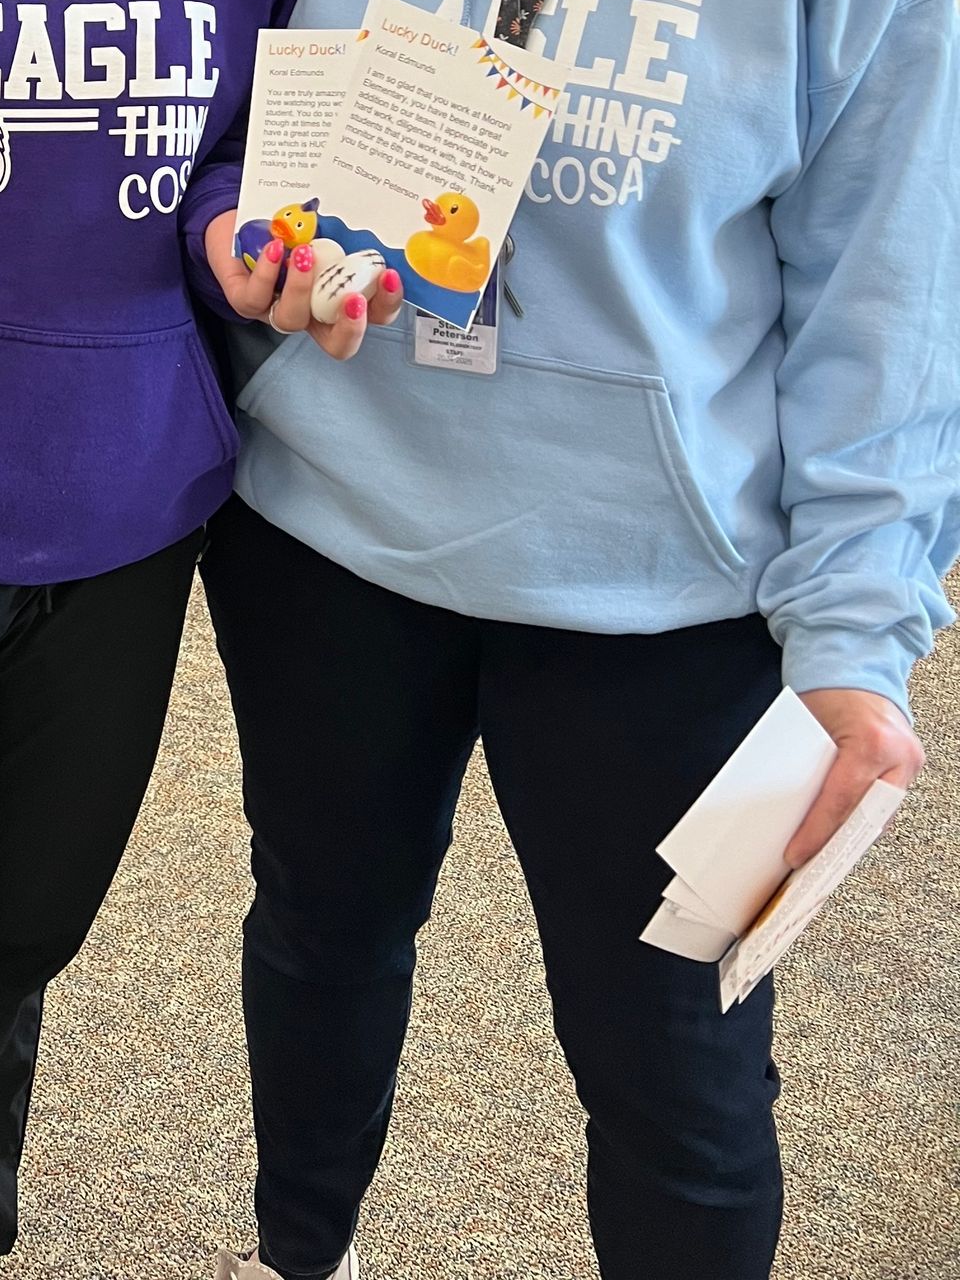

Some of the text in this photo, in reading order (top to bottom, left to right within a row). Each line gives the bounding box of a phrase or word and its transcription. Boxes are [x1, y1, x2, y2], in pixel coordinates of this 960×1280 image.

[268, 43, 346, 58] Lucky Duck!
[382, 17, 459, 57] Lucky Duck!
[267, 88, 283, 97] You
[297, 89, 314, 98] truly
[290, 69, 325, 77] Edmunds
[265, 109, 294, 117] student.
[296, 109, 312, 117] You
[266, 99, 282, 107] love
[283, 99, 316, 109] watching
[317, 101, 331, 109] you
[372, 70, 385, 80] am
[386, 76, 396, 85] so
[396, 80, 416, 93] glad
[416, 87, 433, 100] that
[432, 96, 449, 106] you
[451, 102, 471, 115] work
[471, 111, 482, 120] at
[481, 113, 512, 131] Moroni
[410, 99, 427, 110] you
[427, 105, 448, 119] have
[449, 114, 471, 129] been
[471, 124, 478, 132] a
[479, 127, 502, 141] great
[117, 104, 209, 157] THIN
[264, 119, 290, 128] though
[289, 130, 310, 139] great
[354, 101, 374, 114] hard
[374, 110, 394, 124] work,
[396, 118, 433, 139] diligence
[433, 133, 442, 143] in
[443, 139, 474, 158] serving
[474, 151, 489, 163] the
[358, 90, 389, 109] addition
[390, 103, 400, 112] to
[400, 108, 415, 118] our
[444, 127, 488, 150] appreciate
[488, 145, 509, 158] your
[552, 91, 678, 164] HING
[262, 140, 277, 148] you
[278, 140, 300, 148] which
[301, 140, 308, 148] is
[287, 151, 308, 159] great
[340, 136, 357, 146] you
[357, 140, 369, 151] for
[369, 147, 394, 164] giving
[393, 158, 413, 170] your
[413, 166, 425, 175] all
[425, 172, 449, 188] every
[345, 124, 376, 141] monitor
[376, 136, 390, 148] the
[390, 142, 404, 154] 6th
[404, 150, 429, 164] grade
[470, 175, 496, 194] Thank
[350, 113, 514, 188] students that you work with, and how you
[258, 178, 279, 187] From
[260, 160, 288, 169] making
[333, 155, 420, 200] From Stacey Peterson
[524, 156, 645, 207] COSA
[118, 160, 192, 220] COS
[433, 328, 479, 342] Peterson
